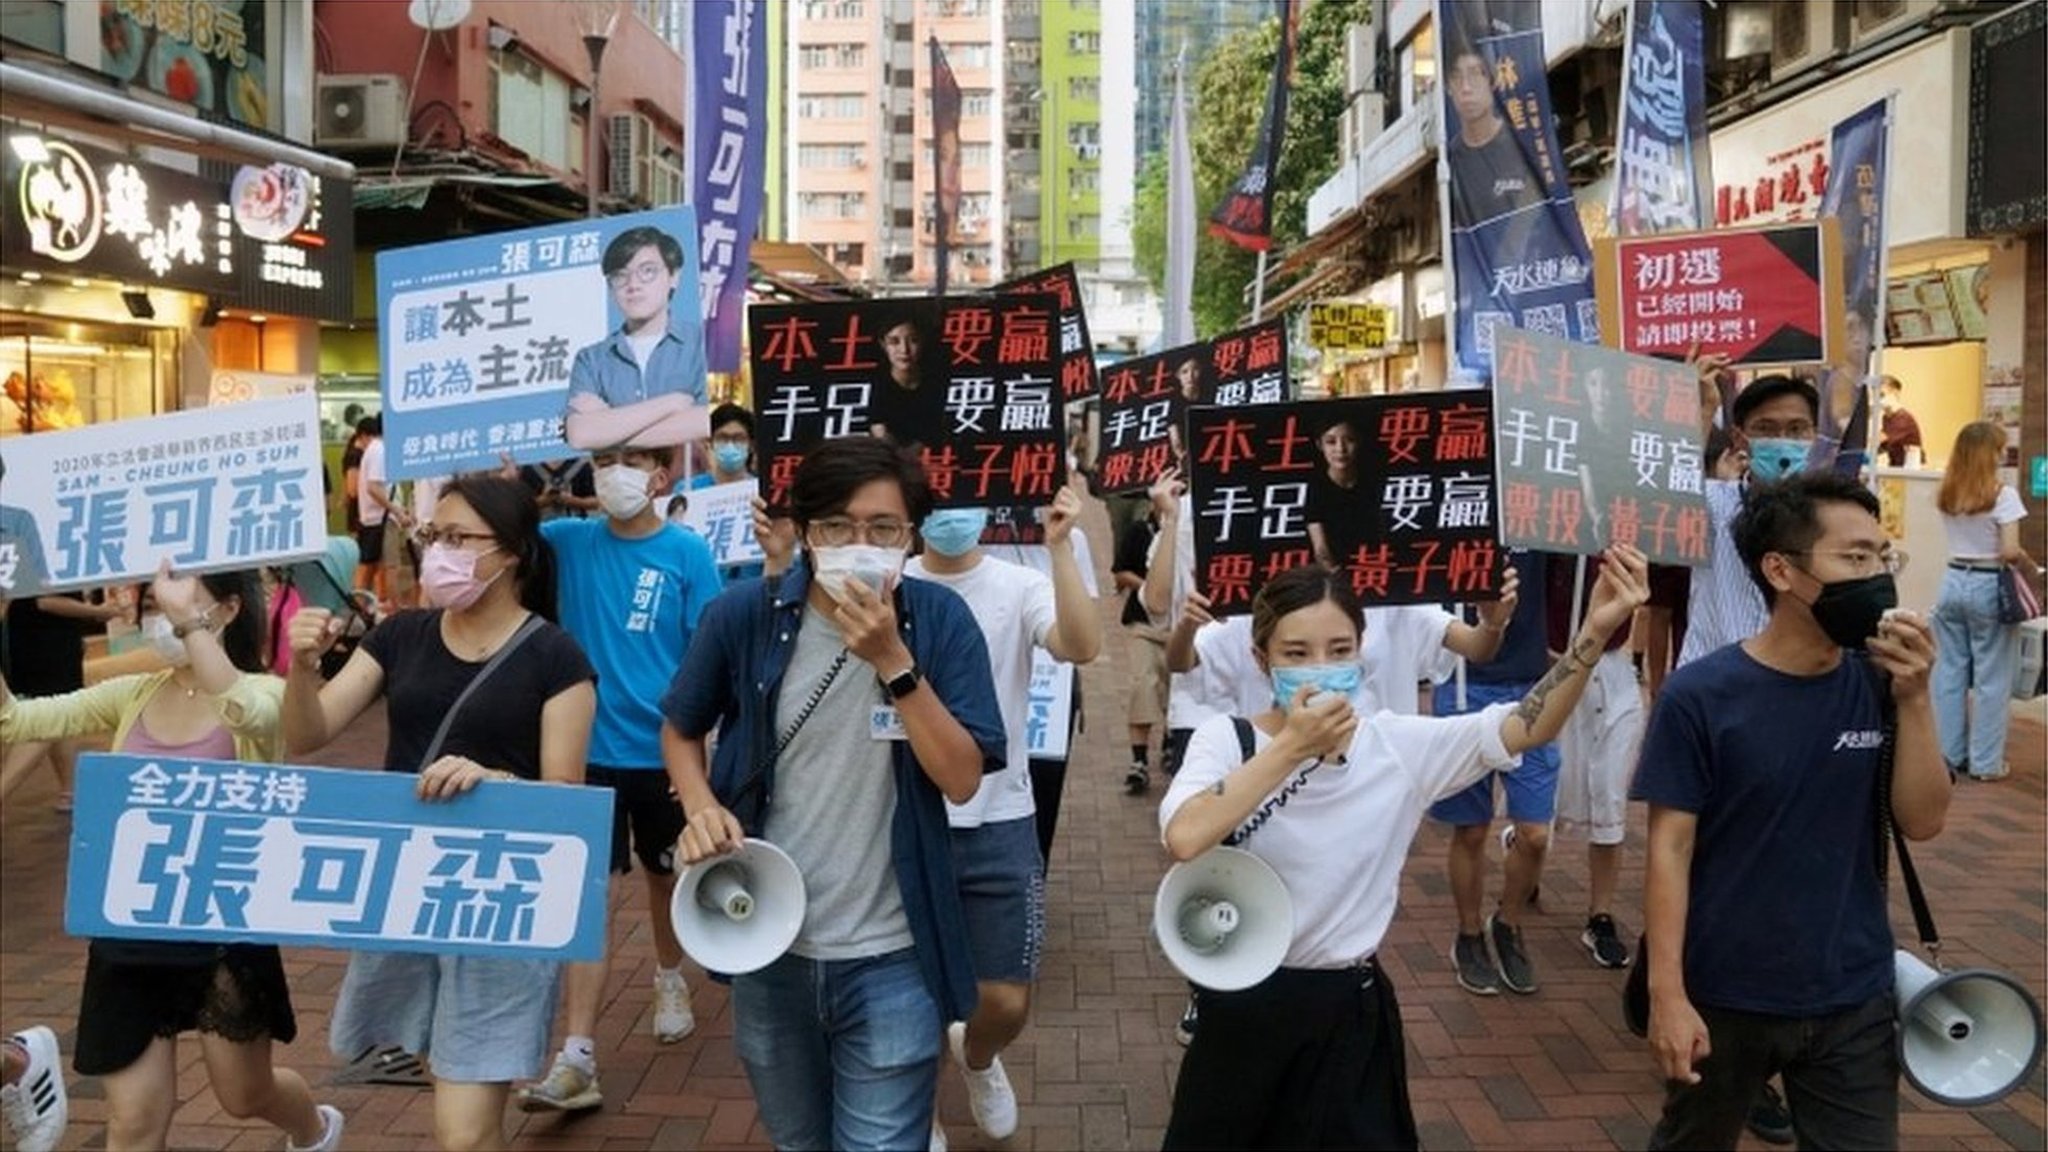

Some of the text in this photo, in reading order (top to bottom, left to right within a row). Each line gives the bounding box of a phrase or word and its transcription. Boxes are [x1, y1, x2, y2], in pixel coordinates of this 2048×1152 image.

[502, 232, 600, 274] 張可森
[1634, 247, 1722, 290] 初選
[403, 283, 532, 343] 讓本土
[1636, 287, 1744, 319] 已經開始
[402, 335, 571, 402] 成為主流
[761, 305, 1050, 373] 本土 要贏
[1105, 330, 1280, 404] 本土 要贏
[763, 373, 1053, 442] 手足 要贏
[1500, 338, 1699, 427] 本土 要贏
[1103, 400, 1171, 447] 手足
[1200, 403, 1489, 474] 本土 要贏
[1501, 407, 1703, 495] 手足 要贏
[57, 474, 101, 493] SAM
[125, 459, 210, 484] CHEUNG
[218, 452, 248, 469] HO
[255, 444, 301, 463] SUM
[55, 468, 309, 581] 張可森
[1200, 472, 1492, 543] 手足 要贏
[1506, 481, 1708, 559] 票投 黃子悅
[1349, 538, 1497, 598] 黃子悅
[127, 762, 308, 813] 全力支持
[131, 810, 554, 942] 張可森
